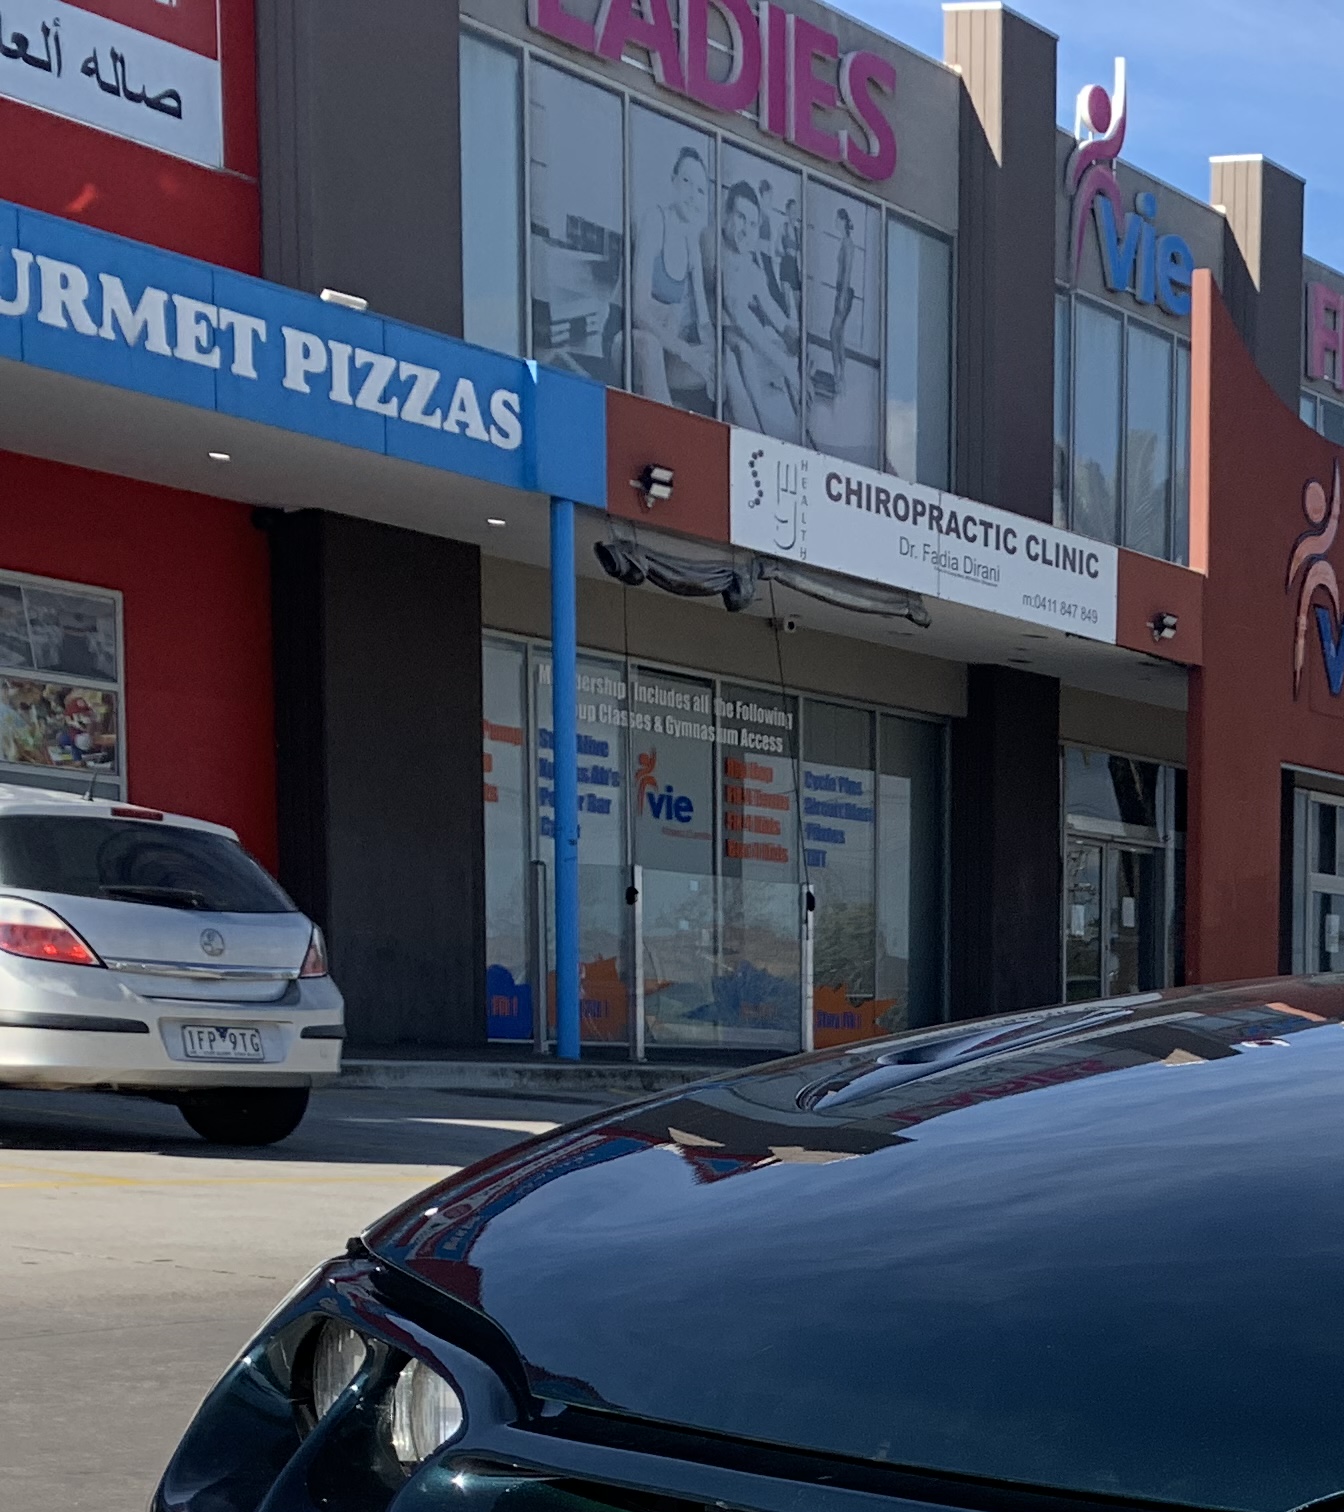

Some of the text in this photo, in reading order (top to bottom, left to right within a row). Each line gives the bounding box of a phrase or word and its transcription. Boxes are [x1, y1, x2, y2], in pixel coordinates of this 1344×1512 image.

[1094, 192, 1193, 317] vie
[282, 326, 523, 451] PIZZAS
[825, 471, 1017, 555] CHIROPRACTIC
[1025, 534, 1099, 580] CLINIC
[899, 536, 918, 560] Dr.
[922, 543, 959, 571] Fadia
[963, 555, 1001, 583] Dirani
[1060, 600, 1078, 619] 847
[1081, 606, 1098, 625] 849
[538, 663, 627, 701] Mership
[634, 681, 690, 711] Includes
[692, 694, 709, 714] all
[653, 715, 664, 733] &
[740, 728, 784, 753] Access
[646, 784, 694, 823] vie
